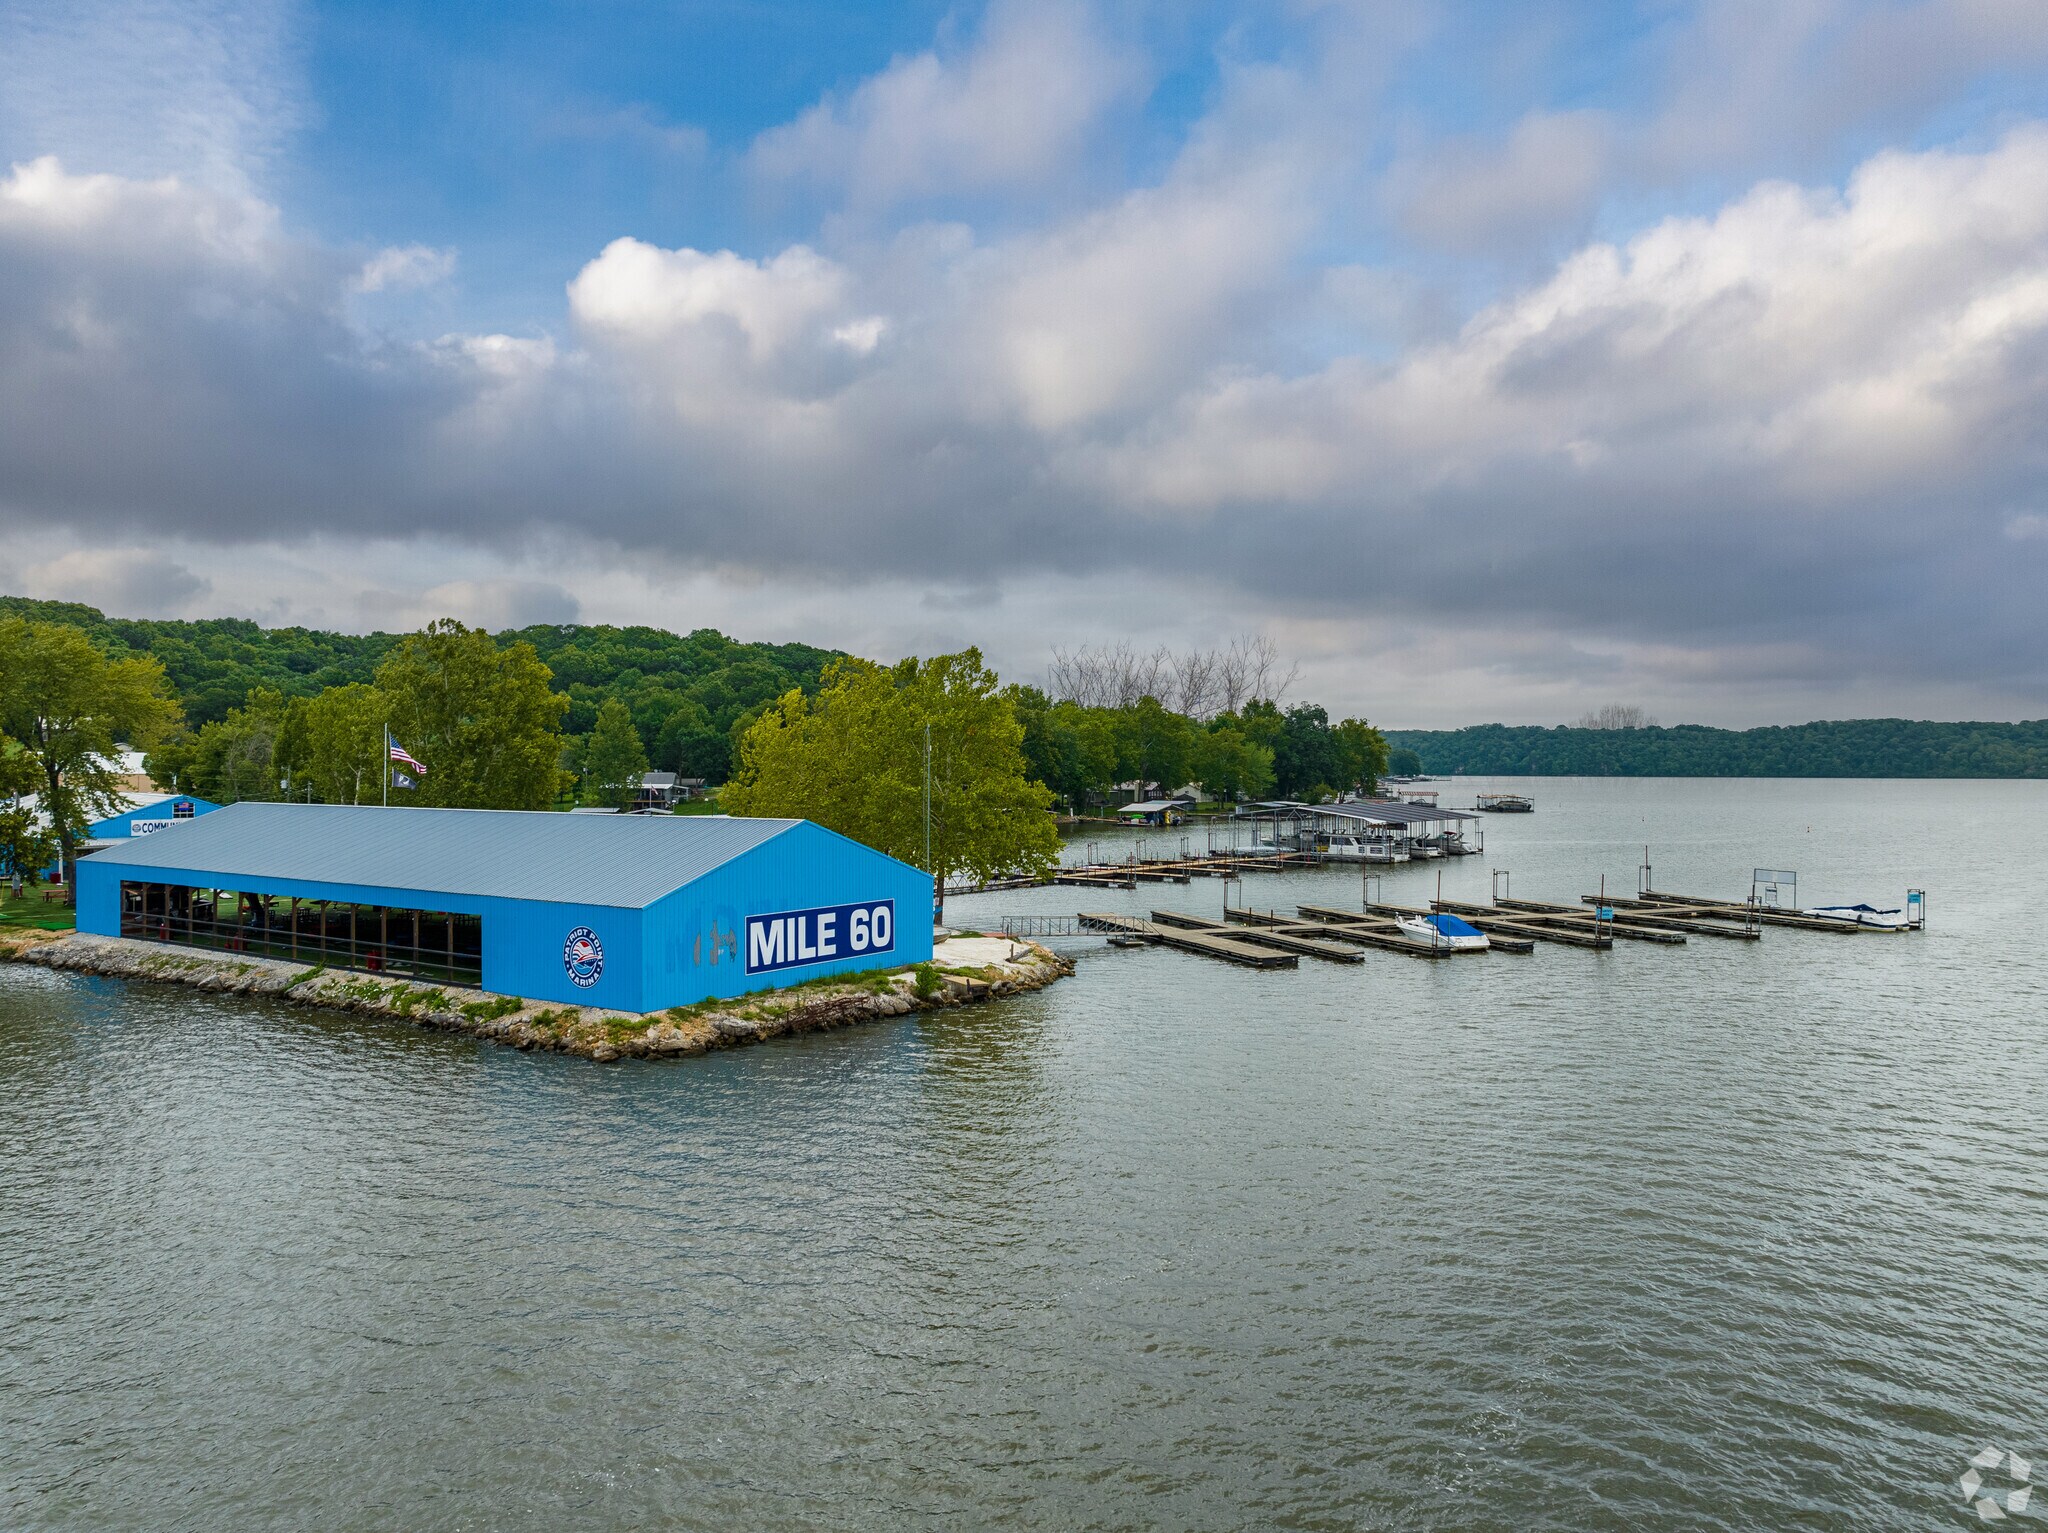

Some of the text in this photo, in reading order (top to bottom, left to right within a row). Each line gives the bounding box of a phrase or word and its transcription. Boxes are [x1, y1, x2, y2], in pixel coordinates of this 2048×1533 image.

[142, 822, 180, 833] COMM
[564, 928, 603, 968] PATRIOT POINT
[750, 906, 891, 968] MILE 60
[568, 968, 600, 987] MARINA
